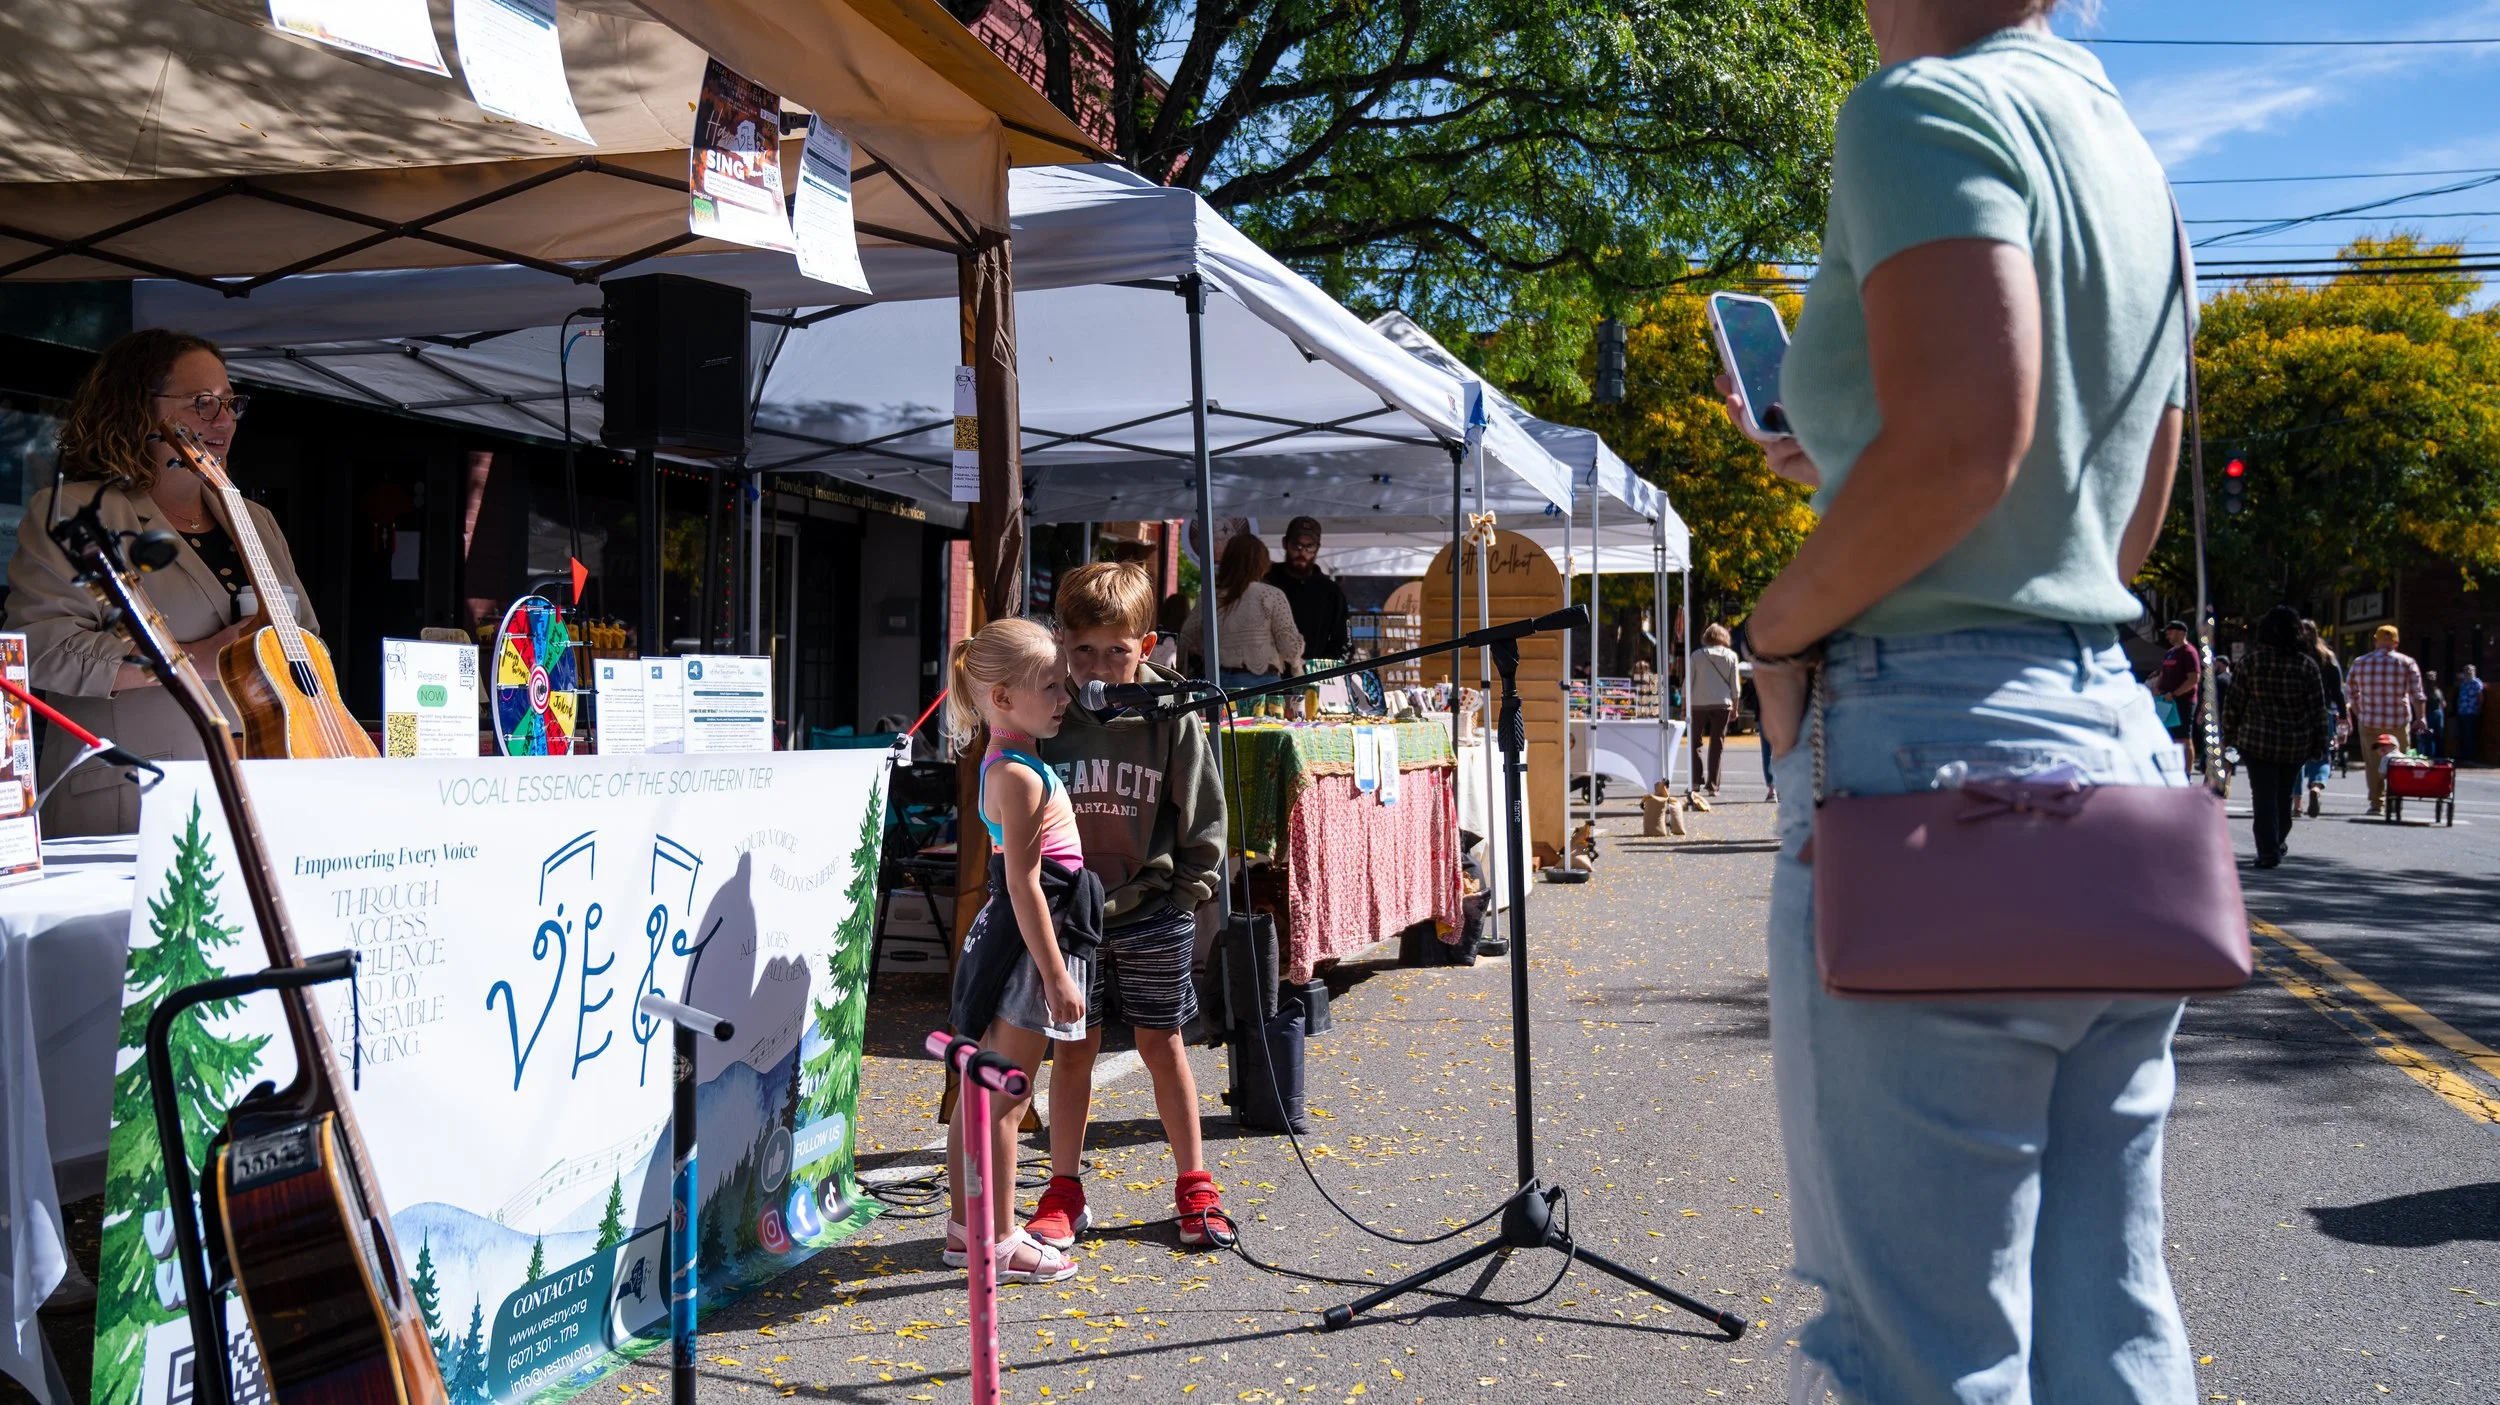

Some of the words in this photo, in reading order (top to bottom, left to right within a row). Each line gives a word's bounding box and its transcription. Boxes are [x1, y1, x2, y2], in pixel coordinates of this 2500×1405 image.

[706, 149, 745, 181] SING
[775, 476, 813, 497] Providing
[815, 484, 851, 505] Insurance
[852, 493, 867, 508] and
[867, 496, 899, 515] Financial
[899, 501, 927, 520] Services
[417, 670, 447, 683] Register
[420, 690, 446, 701] NOW
[438, 777, 510, 806] VOCAL
[516, 773, 603, 803] ESSENCE
[608, 772, 634, 797] OF
[638, 771, 665, 796] THE
[668, 767, 744, 794] SOUTHERN
[748, 766, 773, 790] TIER
[1055, 759, 1110, 796] EAN
[1513, 799, 1522, 823] frame
[294, 849, 396, 880] Empowering
[399, 846, 440, 868] Every
[443, 841, 479, 861] Voice
[734, 829, 766, 861] YOUR
[768, 828, 799, 855] VOICE
[769, 862, 814, 893] BELONGS
[331, 879, 440, 919] THROUGH
[359, 937, 446, 979] ELLENCE,
[740, 934, 760, 960] ALL
[762, 931, 789, 950] AGES
[338, 979, 383, 1013] AND
[388, 970, 423, 1002] JOY
[765, 963, 785, 982] ALL
[341, 994, 445, 1044] ENSEMBLE
[795, 1129, 829, 1157] FOLLOW
[829, 1123, 841, 1143] US
[512, 1272, 577, 1319] CONTACT
[577, 1264, 596, 1287] US
[508, 1298, 588, 1347] www.vestny.org
[506, 1346, 534, 1374] (607)
[535, 1337, 552, 1366] 301
[560, 1322, 579, 1343] 1719
[510, 1342, 593, 1395] info@vestny.org
